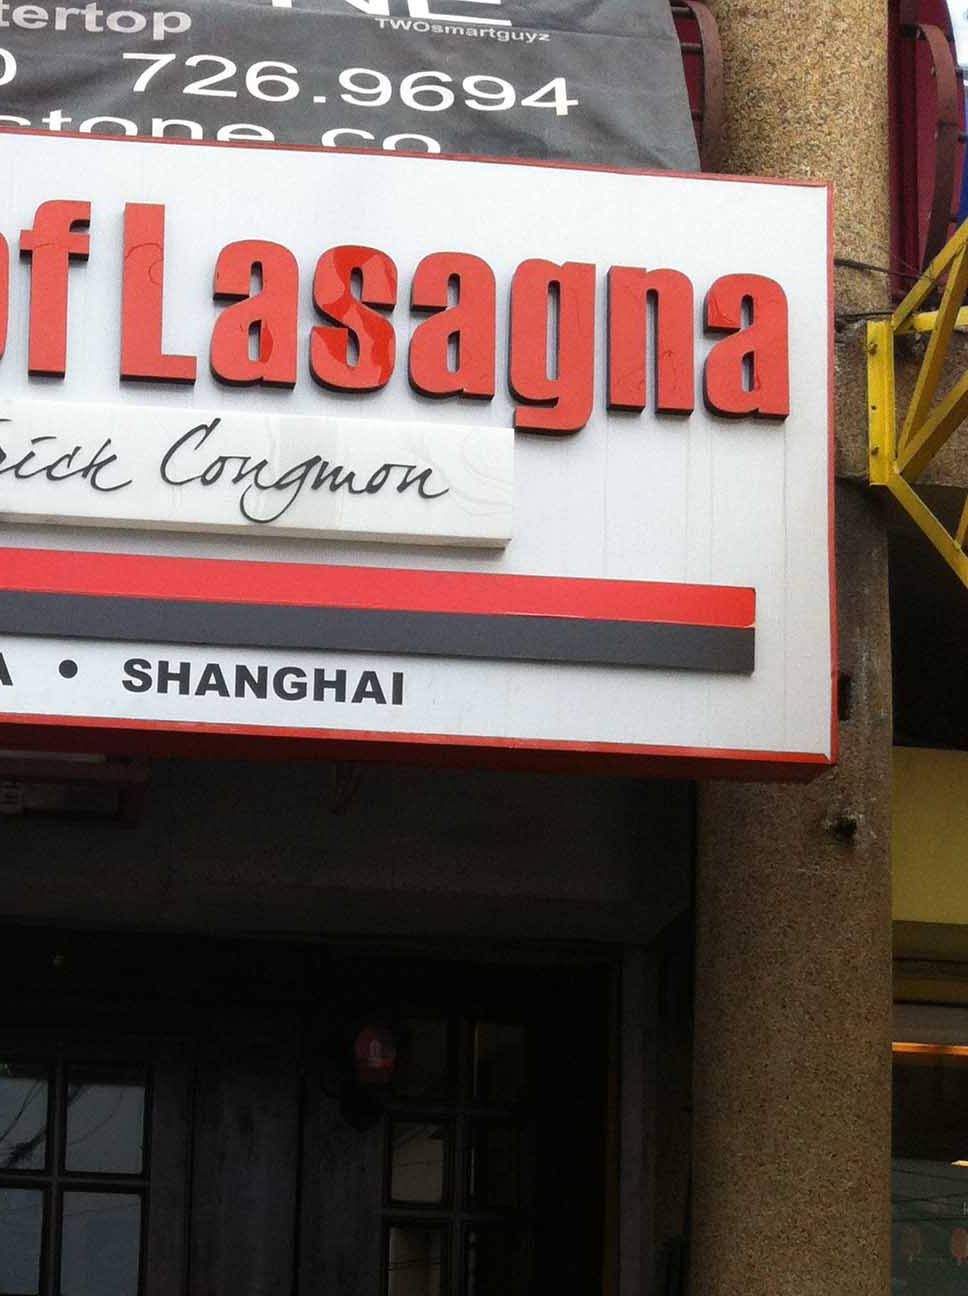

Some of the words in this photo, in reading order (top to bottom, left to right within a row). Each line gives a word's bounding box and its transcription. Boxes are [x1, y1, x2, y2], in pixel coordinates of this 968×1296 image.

[375, 17, 551, 43] TWOsmartguyz
[122, 51, 580, 118] 726.9694
[119, 202, 790, 435] Lasagna
[158, 417, 450, 524] Congmon
[121, 657, 405, 706] SHANGHAI
